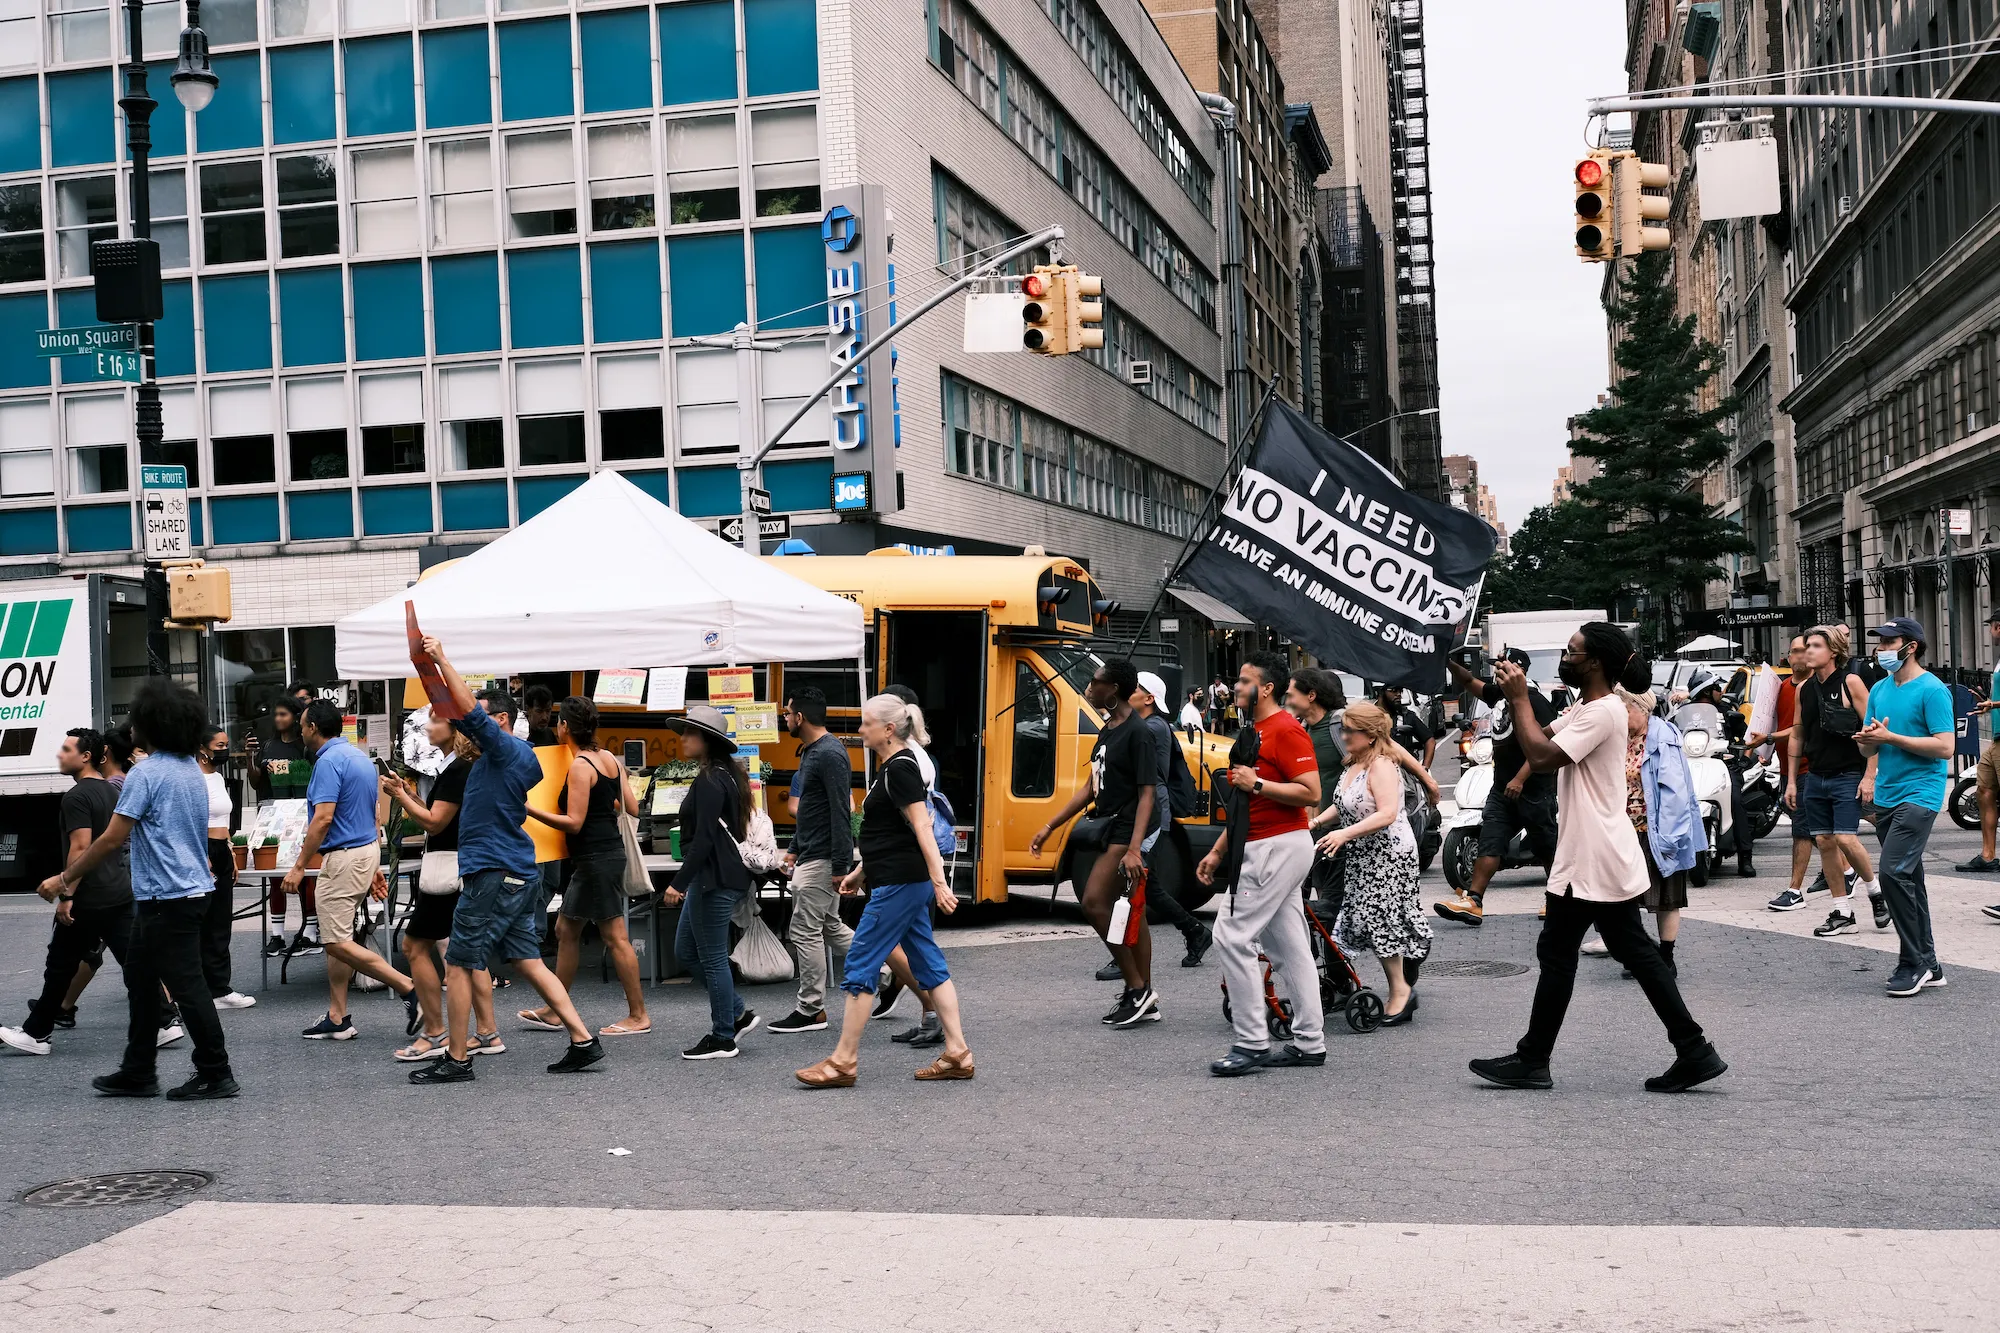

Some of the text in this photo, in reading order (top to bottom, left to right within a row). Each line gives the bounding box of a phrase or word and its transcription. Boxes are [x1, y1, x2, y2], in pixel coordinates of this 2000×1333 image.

[40, 329, 133, 348] Union Square
[78, 346, 95, 354] Wes
[828, 261, 864, 450] CHASE
[97, 353, 136, 377] E 16 St
[144, 472, 183, 484] BIKE ROUTE
[835, 481, 866, 503] Joe
[1229, 474, 1283, 524] NO
[1309, 468, 1436, 556] I NEED
[148, 519, 186, 533] SHARED
[729, 522, 780, 536] ON WAY
[156, 538, 180, 551] LANE
[1208, 525, 1435, 653] I HAVE AN IMMUNE SYSTEM
[1736, 613, 1784, 621] TsuruTonTan
[276, 763, 287, 772] $6
